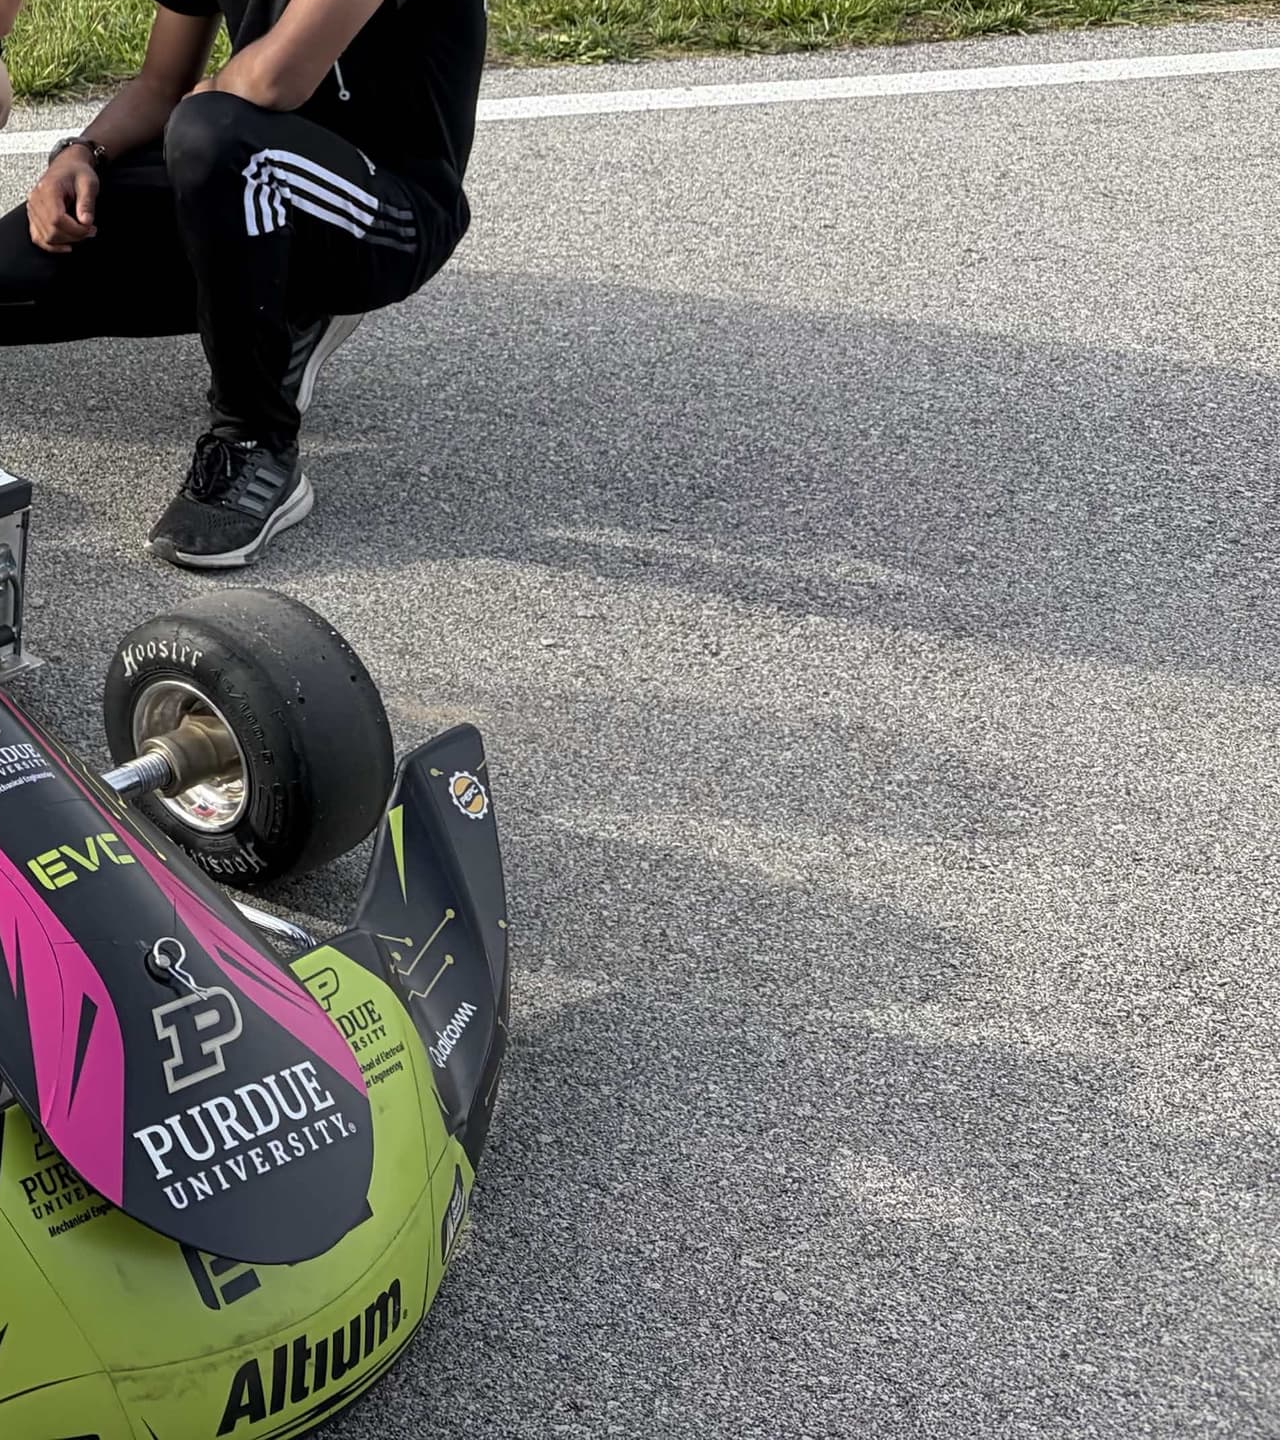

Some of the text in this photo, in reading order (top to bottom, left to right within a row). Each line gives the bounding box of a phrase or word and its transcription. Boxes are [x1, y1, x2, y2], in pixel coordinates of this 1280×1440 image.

[121, 639, 204, 677] Hoosier
[27, 832, 136, 890] EVC
[335, 1000, 382, 1040] DUE
[351, 1024, 387, 1053] RSITY
[428, 999, 478, 1069] Qualcomm
[381, 1041, 405, 1063] Electrical
[133, 1060, 336, 1181] PURDUE
[162, 1113, 351, 1211] UNIVERSITY
[19, 1162, 80, 1205] PUR
[32, 1187, 95, 1220] UNIVE
[48, 1208, 92, 1238] Mechanical
[216, 1278, 404, 1438] Altium
